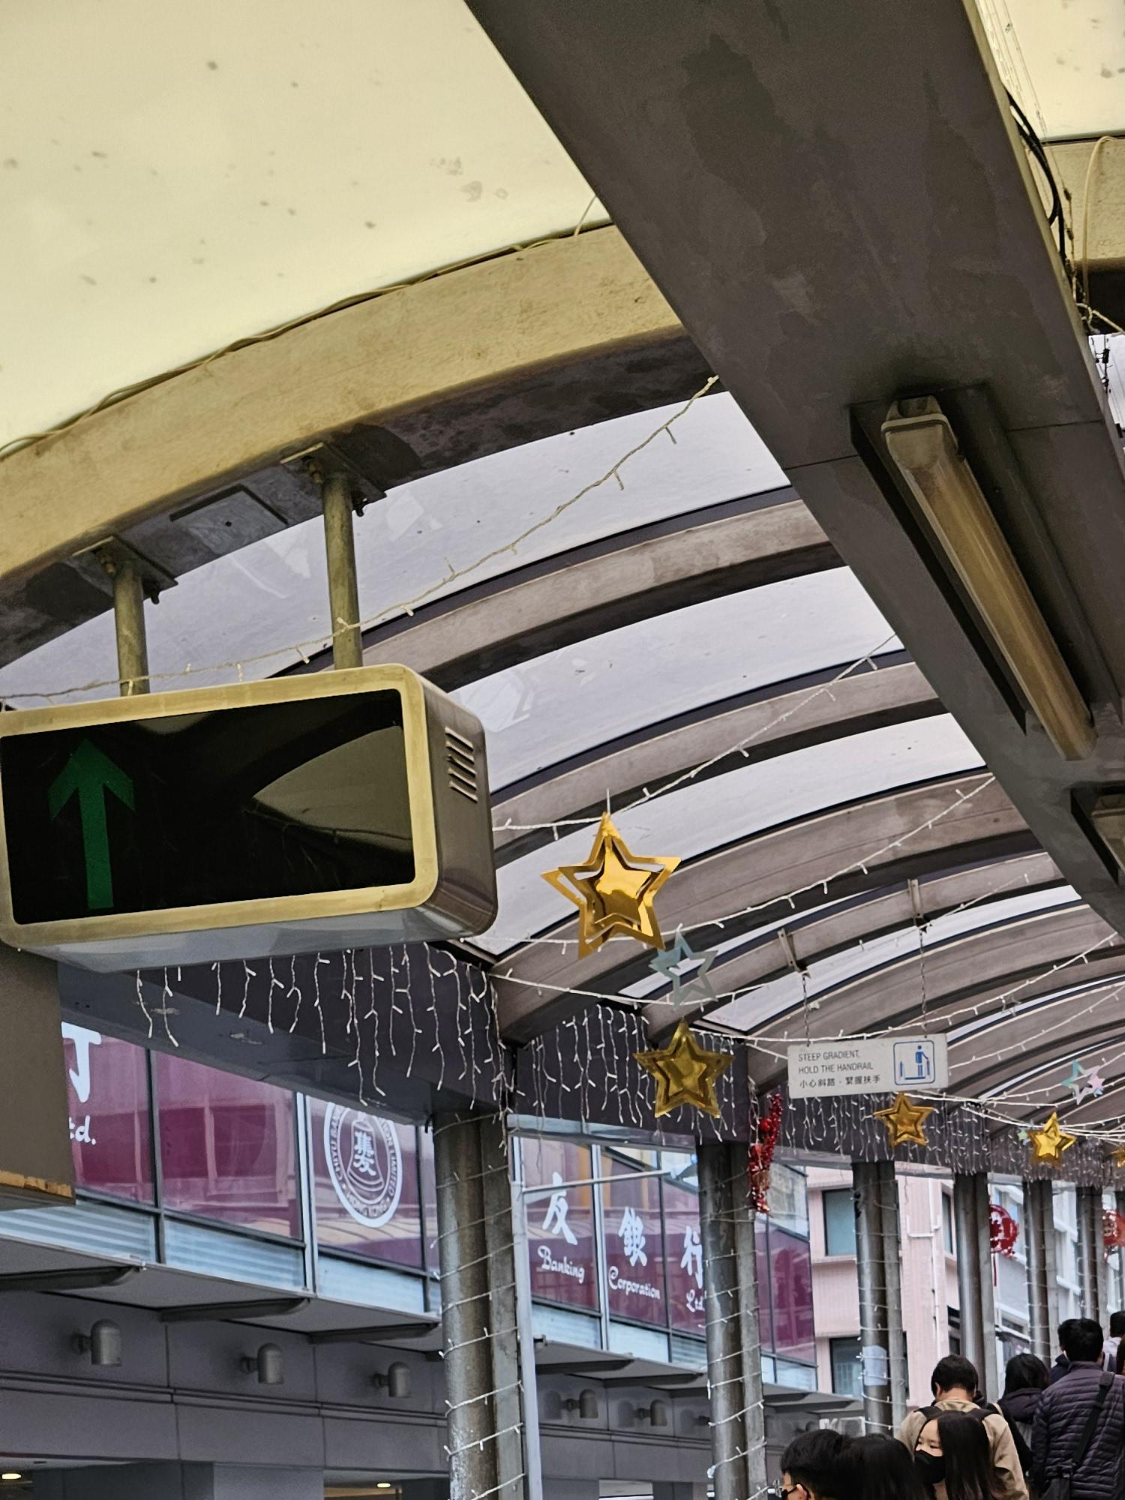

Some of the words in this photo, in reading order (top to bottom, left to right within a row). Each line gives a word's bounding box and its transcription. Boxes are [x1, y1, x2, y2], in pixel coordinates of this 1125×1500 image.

[798, 1051, 820, 1062] STEEP
[799, 1065, 818, 1075] HOLD
[821, 1064, 834, 1073] THE
[836, 1062, 874, 1071] HANDRAIL
[537, 1246, 585, 1284] Banking
[608, 1266, 661, 1300] Corporation
